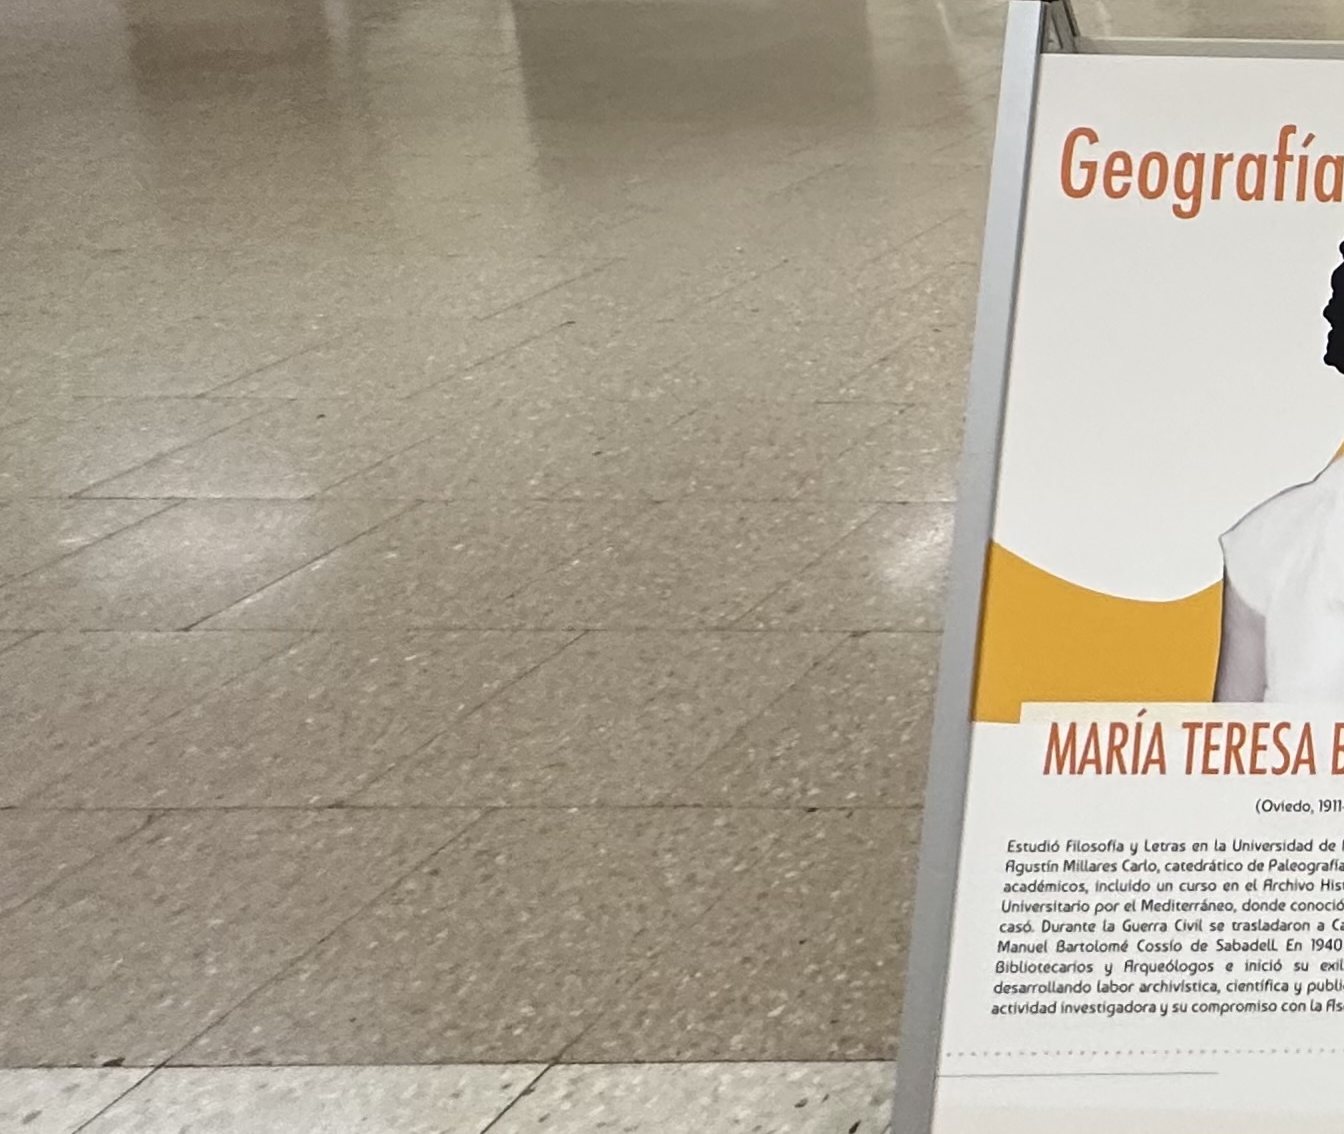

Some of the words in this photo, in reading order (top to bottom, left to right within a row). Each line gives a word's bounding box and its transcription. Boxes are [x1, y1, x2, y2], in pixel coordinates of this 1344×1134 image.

[1061, 125, 1344, 220] Geografía
[1044, 708, 1166, 775] MARÍA
[1182, 722, 1315, 775] TERESA
[1254, 797, 1314, 815] (Oviedo,
[1006, 838, 1060, 854] Estudió
[1065, 838, 1125, 853] Filosofía
[1129, 842, 1139, 857] y
[1143, 838, 1187, 853] Letras
[1191, 841, 1209, 853] en
[1213, 838, 1227, 853] la
[1231, 837, 1314, 853] Universidad
[1317, 837, 1337, 853] de
[996, 938, 1048, 954] Manuel
[1055, 938, 1129, 954] Bartolomé
[1136, 937, 1183, 953] Cossío
[1189, 938, 1209, 953] de
[1285, 937, 1303, 952] En
[1310, 937, 1343, 953] 1940
[990, 1000, 1058, 1015] actividad
[1060, 999, 1157, 1018] investigadora
[1159, 1002, 1169, 1017] y
[1171, 1002, 1188, 1014] su
[1190, 999, 1278, 1017] compromiso
[1280, 1001, 1307, 1013] con
[1309, 997, 1323, 1013] la
